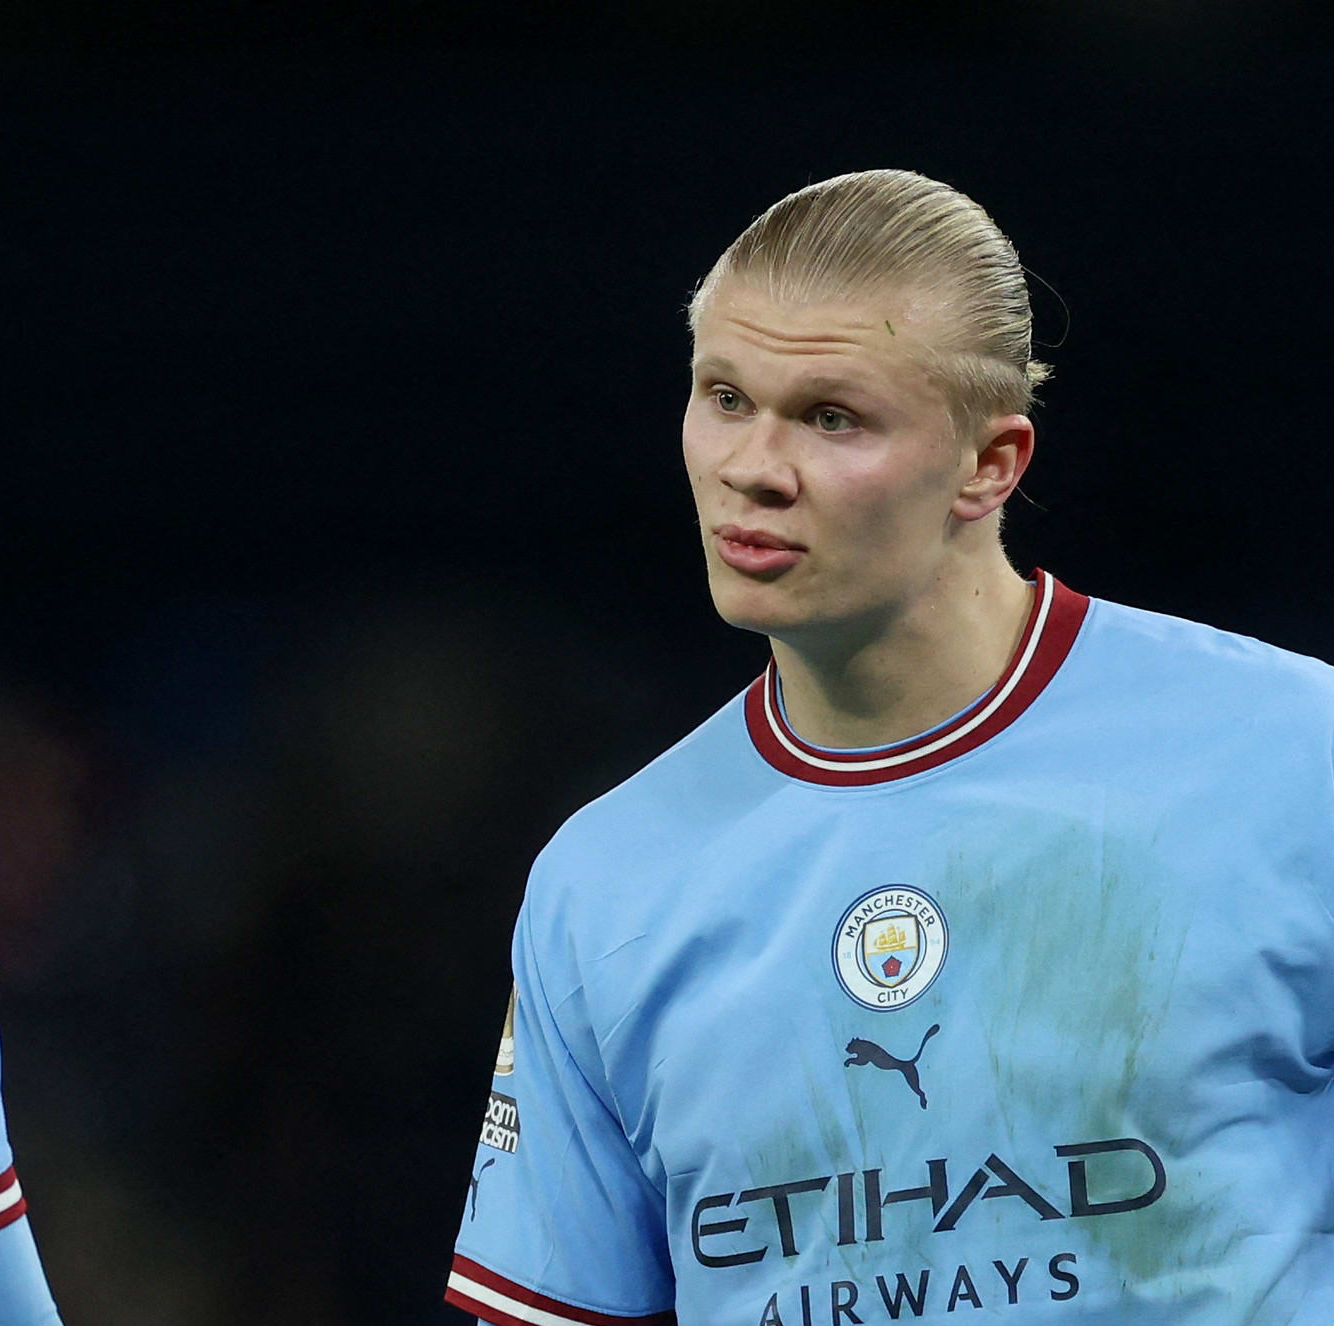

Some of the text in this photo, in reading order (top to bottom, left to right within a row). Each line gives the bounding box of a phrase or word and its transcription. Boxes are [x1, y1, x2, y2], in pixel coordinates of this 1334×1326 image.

[845, 894, 936, 938] MANCHESTER
[877, 988, 909, 1003] CITY
[690, 1136, 1168, 1268] ETIHAD
